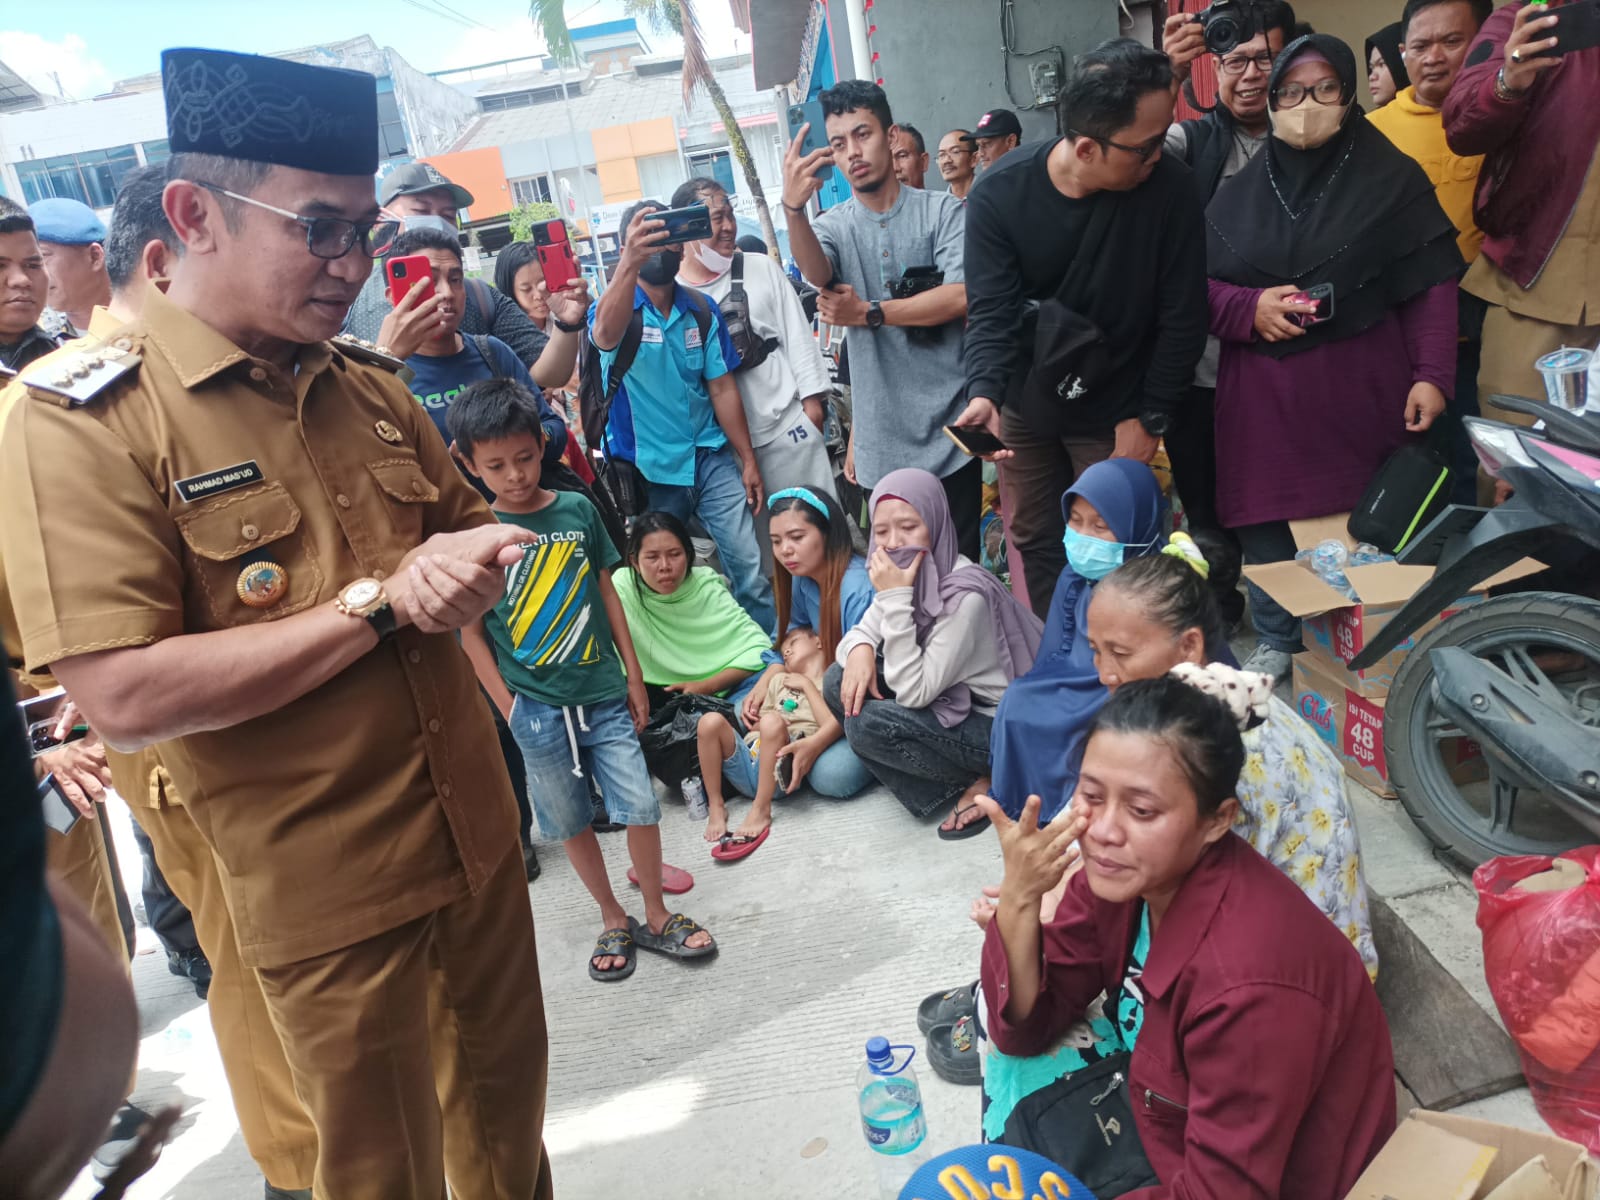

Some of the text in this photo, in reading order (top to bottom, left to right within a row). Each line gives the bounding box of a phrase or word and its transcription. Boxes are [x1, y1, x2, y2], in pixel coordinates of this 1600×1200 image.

[787, 425, 808, 443] 75
[188, 468, 254, 493] RAHMAD MAS'UD
[522, 549, 537, 575] CLOTHING
[1336, 624, 1354, 649] 48
[1348, 702, 1383, 729] ISI TETAP
[1350, 722, 1374, 750] 48
[1352, 743, 1375, 762] CUP
